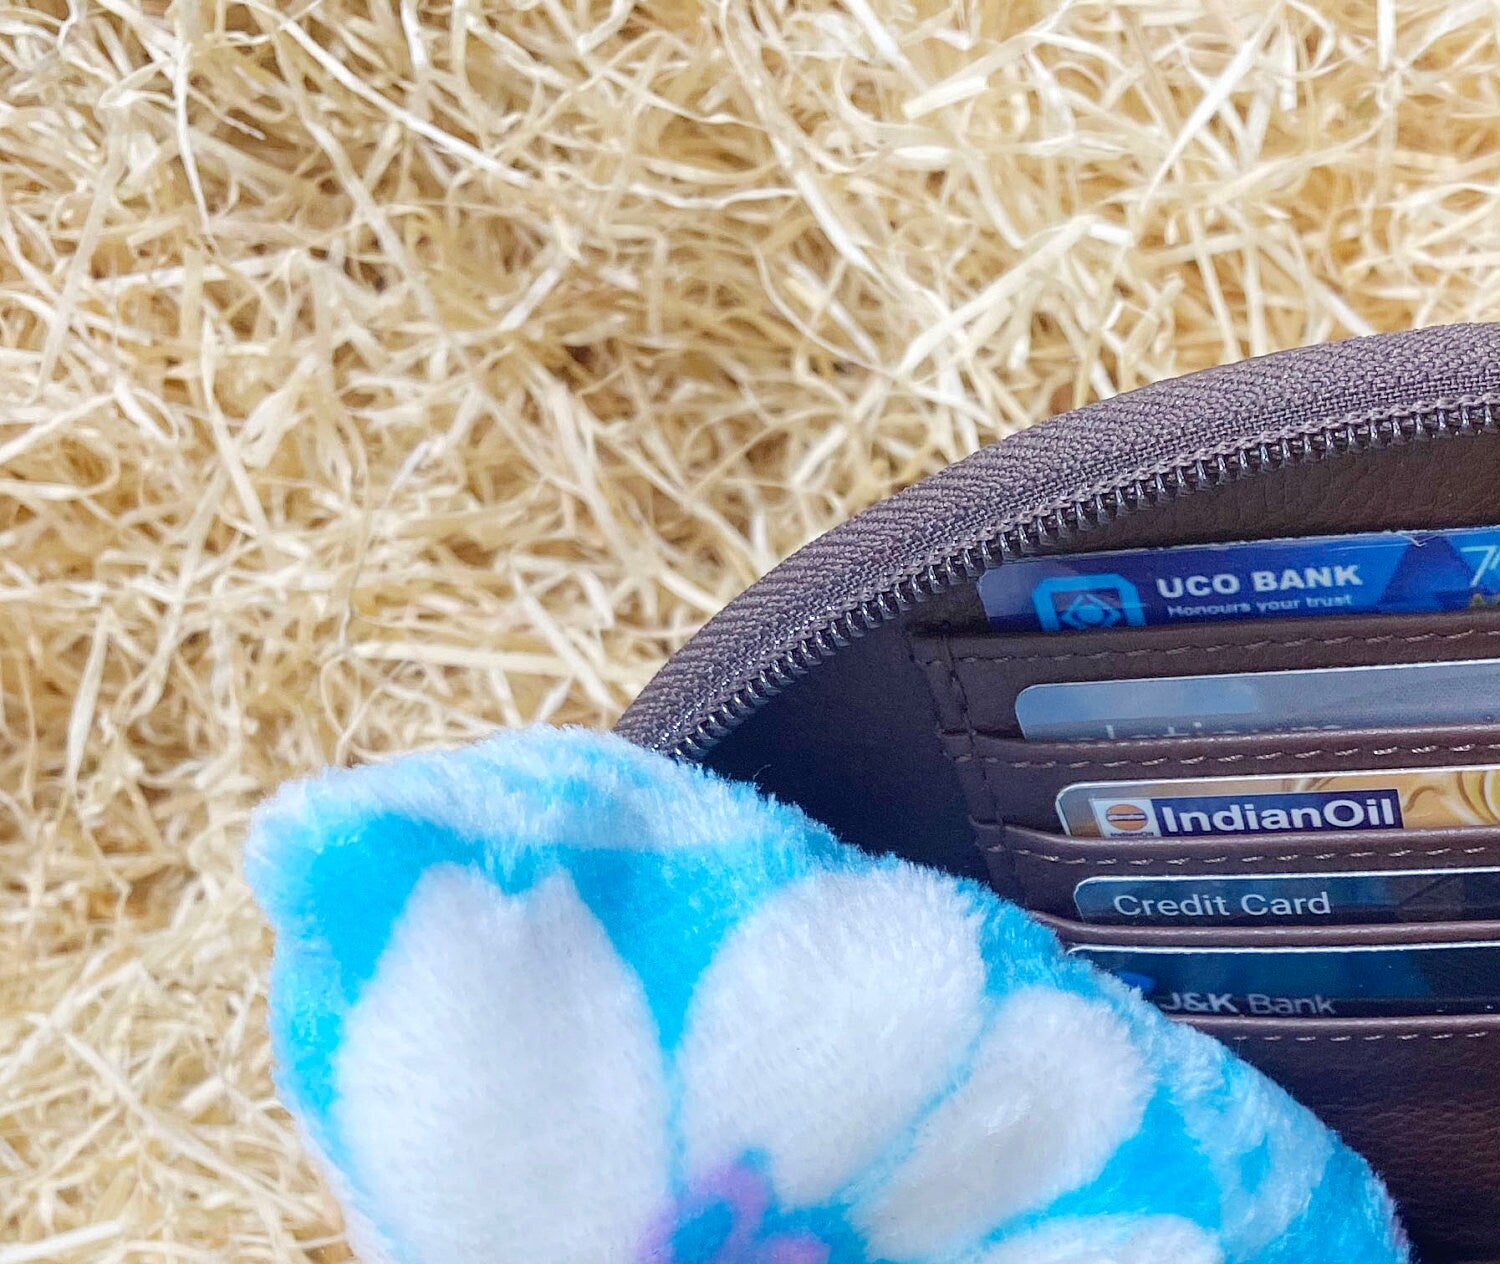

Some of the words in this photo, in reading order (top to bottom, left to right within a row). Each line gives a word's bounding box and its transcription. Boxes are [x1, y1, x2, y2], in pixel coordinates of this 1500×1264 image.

[1156, 573, 1241, 599] UCO
[1253, 563, 1364, 592] BANK
[1167, 602, 1251, 618] Honours
[1256, 599, 1301, 614] your
[1305, 593, 1354, 608] trust
[1160, 798, 1396, 834] IndianOil
[1113, 894, 1230, 917] Credit
[1240, 891, 1332, 916] Card
[1157, 991, 1240, 1014] J&K
[1246, 992, 1337, 1015] Bank
